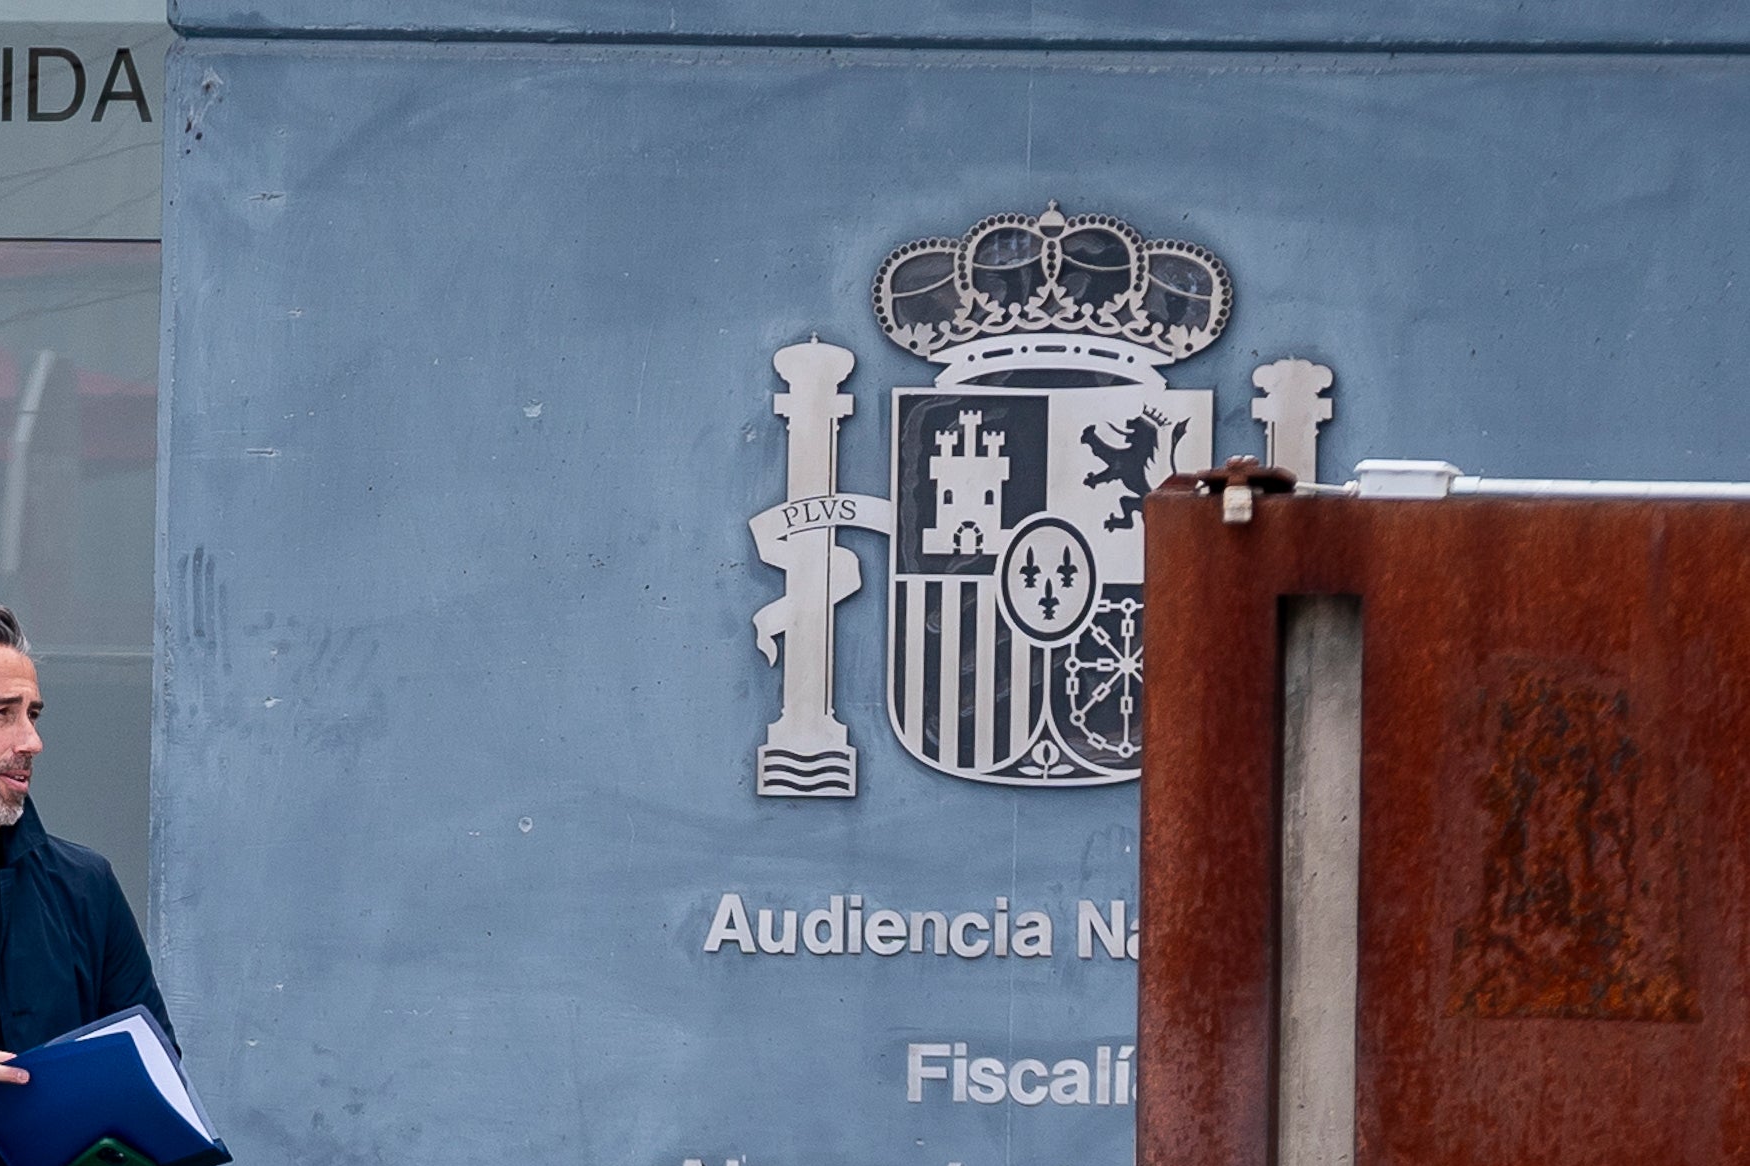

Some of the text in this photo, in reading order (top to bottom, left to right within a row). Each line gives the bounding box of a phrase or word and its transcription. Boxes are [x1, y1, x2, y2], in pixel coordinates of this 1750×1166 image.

[781, 499, 857, 529] PLVS
[704, 893, 1052, 958] Audiencia
[905, 1042, 1137, 1106] Fiscalí
